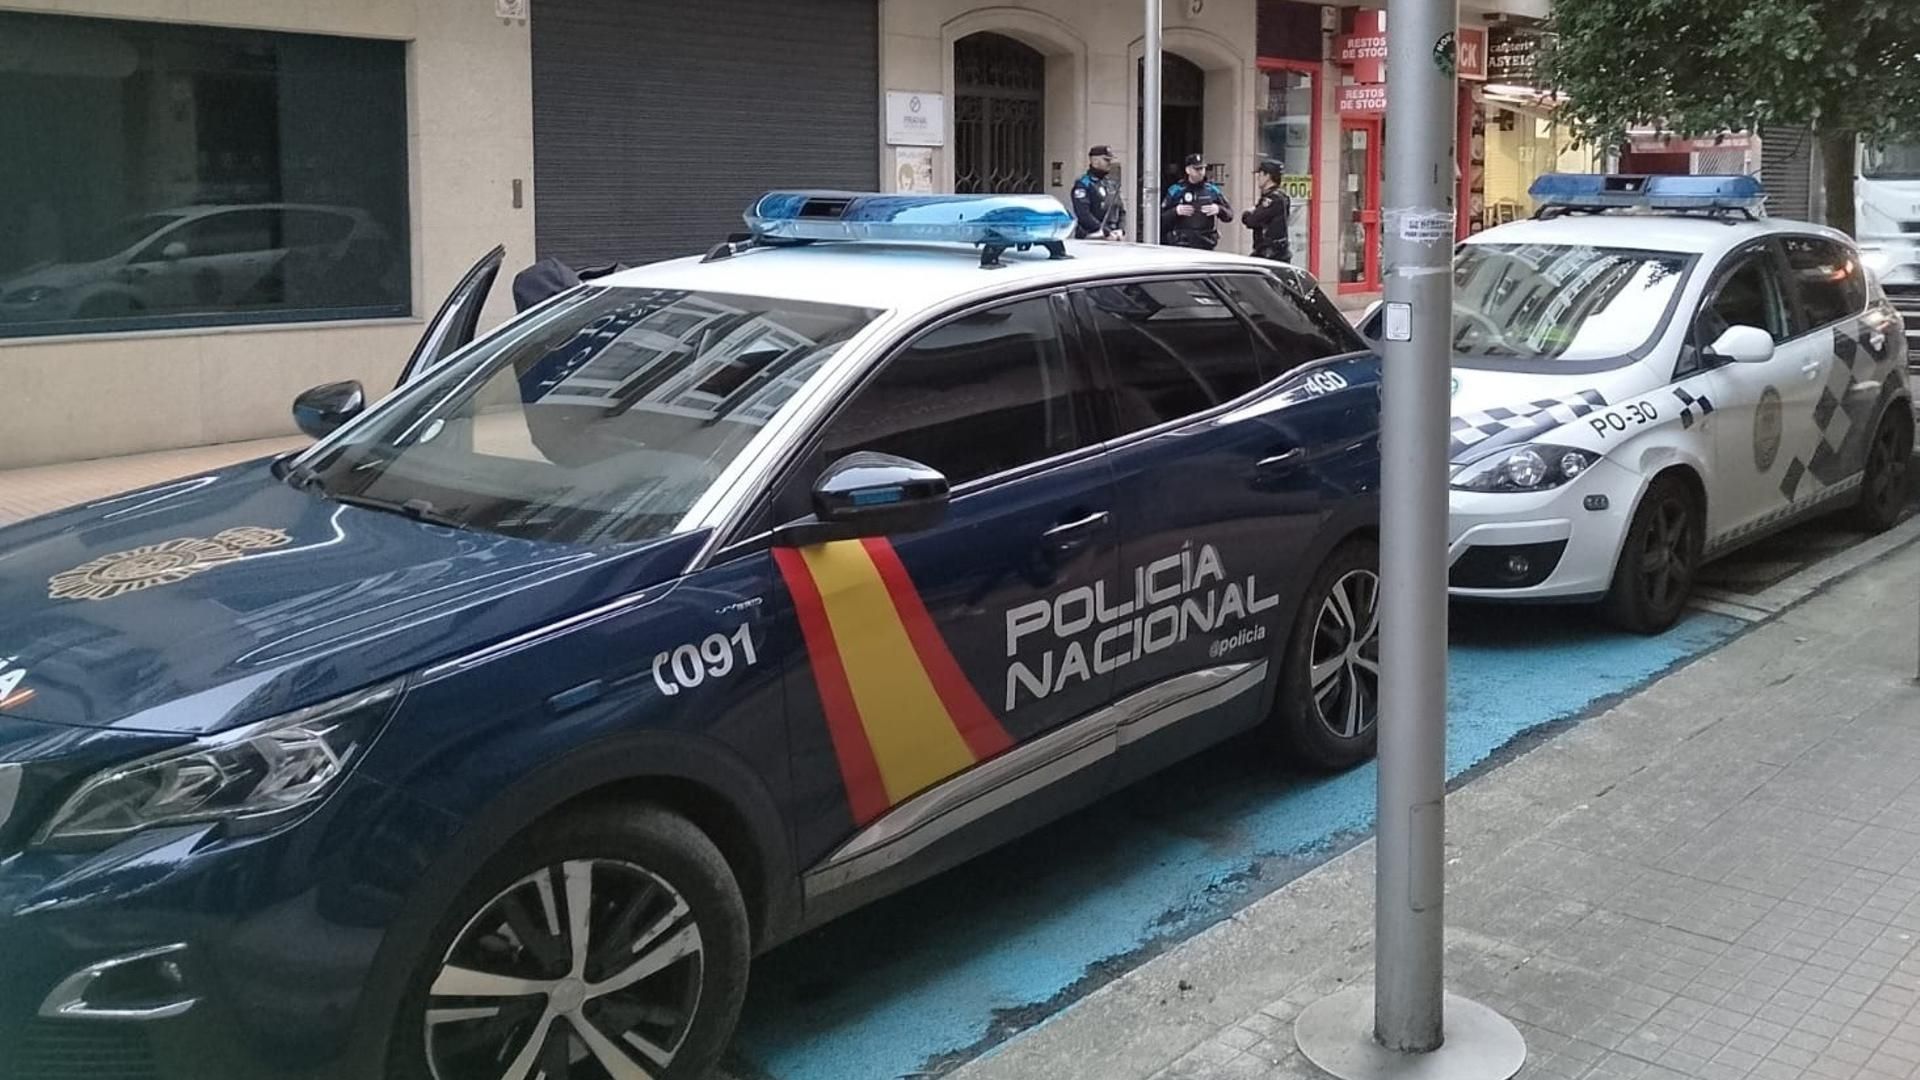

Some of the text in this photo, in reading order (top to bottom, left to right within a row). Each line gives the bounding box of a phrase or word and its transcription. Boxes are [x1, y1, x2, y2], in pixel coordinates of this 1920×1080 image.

[1347, 37, 1386, 49] RESTOS
[1342, 49, 1356, 59] DE
[1460, 42, 1477, 68] CK
[1345, 88, 1385, 100] RESTOS
[1340, 101, 1354, 111] DE
[1589, 401, 1658, 438] PO-30
[1006, 540, 1224, 657] POLICÍA
[1005, 575, 1279, 712] NACIONAL
